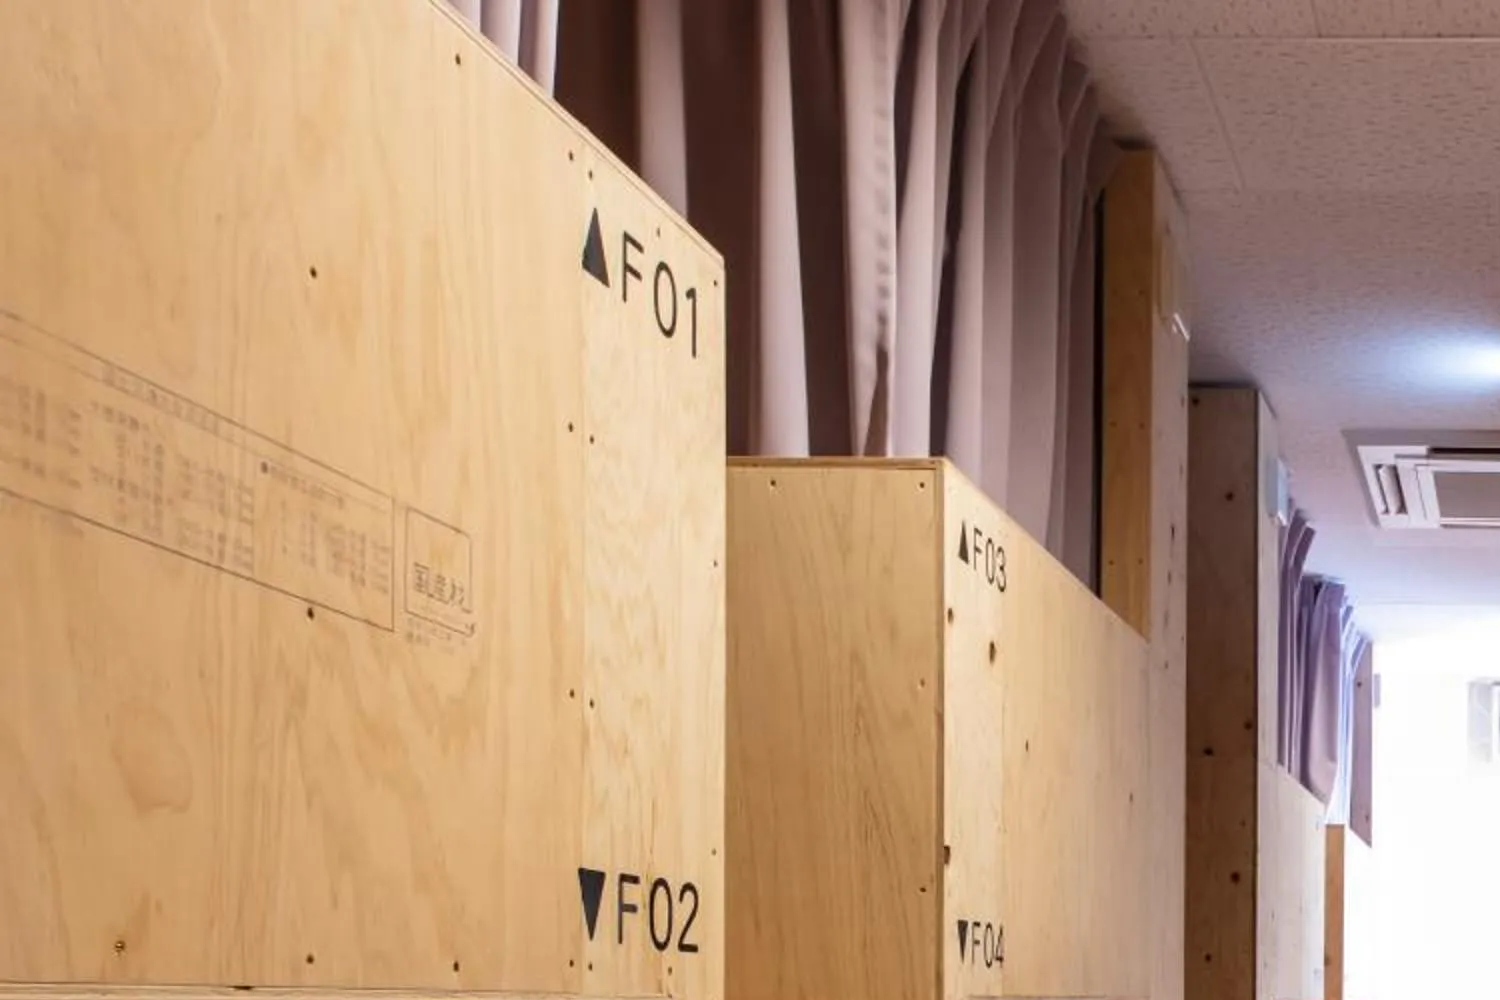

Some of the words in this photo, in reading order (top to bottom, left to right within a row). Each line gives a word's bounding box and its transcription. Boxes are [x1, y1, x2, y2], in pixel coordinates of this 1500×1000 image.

[622, 230, 697, 359] F01
[973, 527, 1007, 593] F03
[617, 872, 699, 953] F02
[971, 921, 1004, 969] F04
